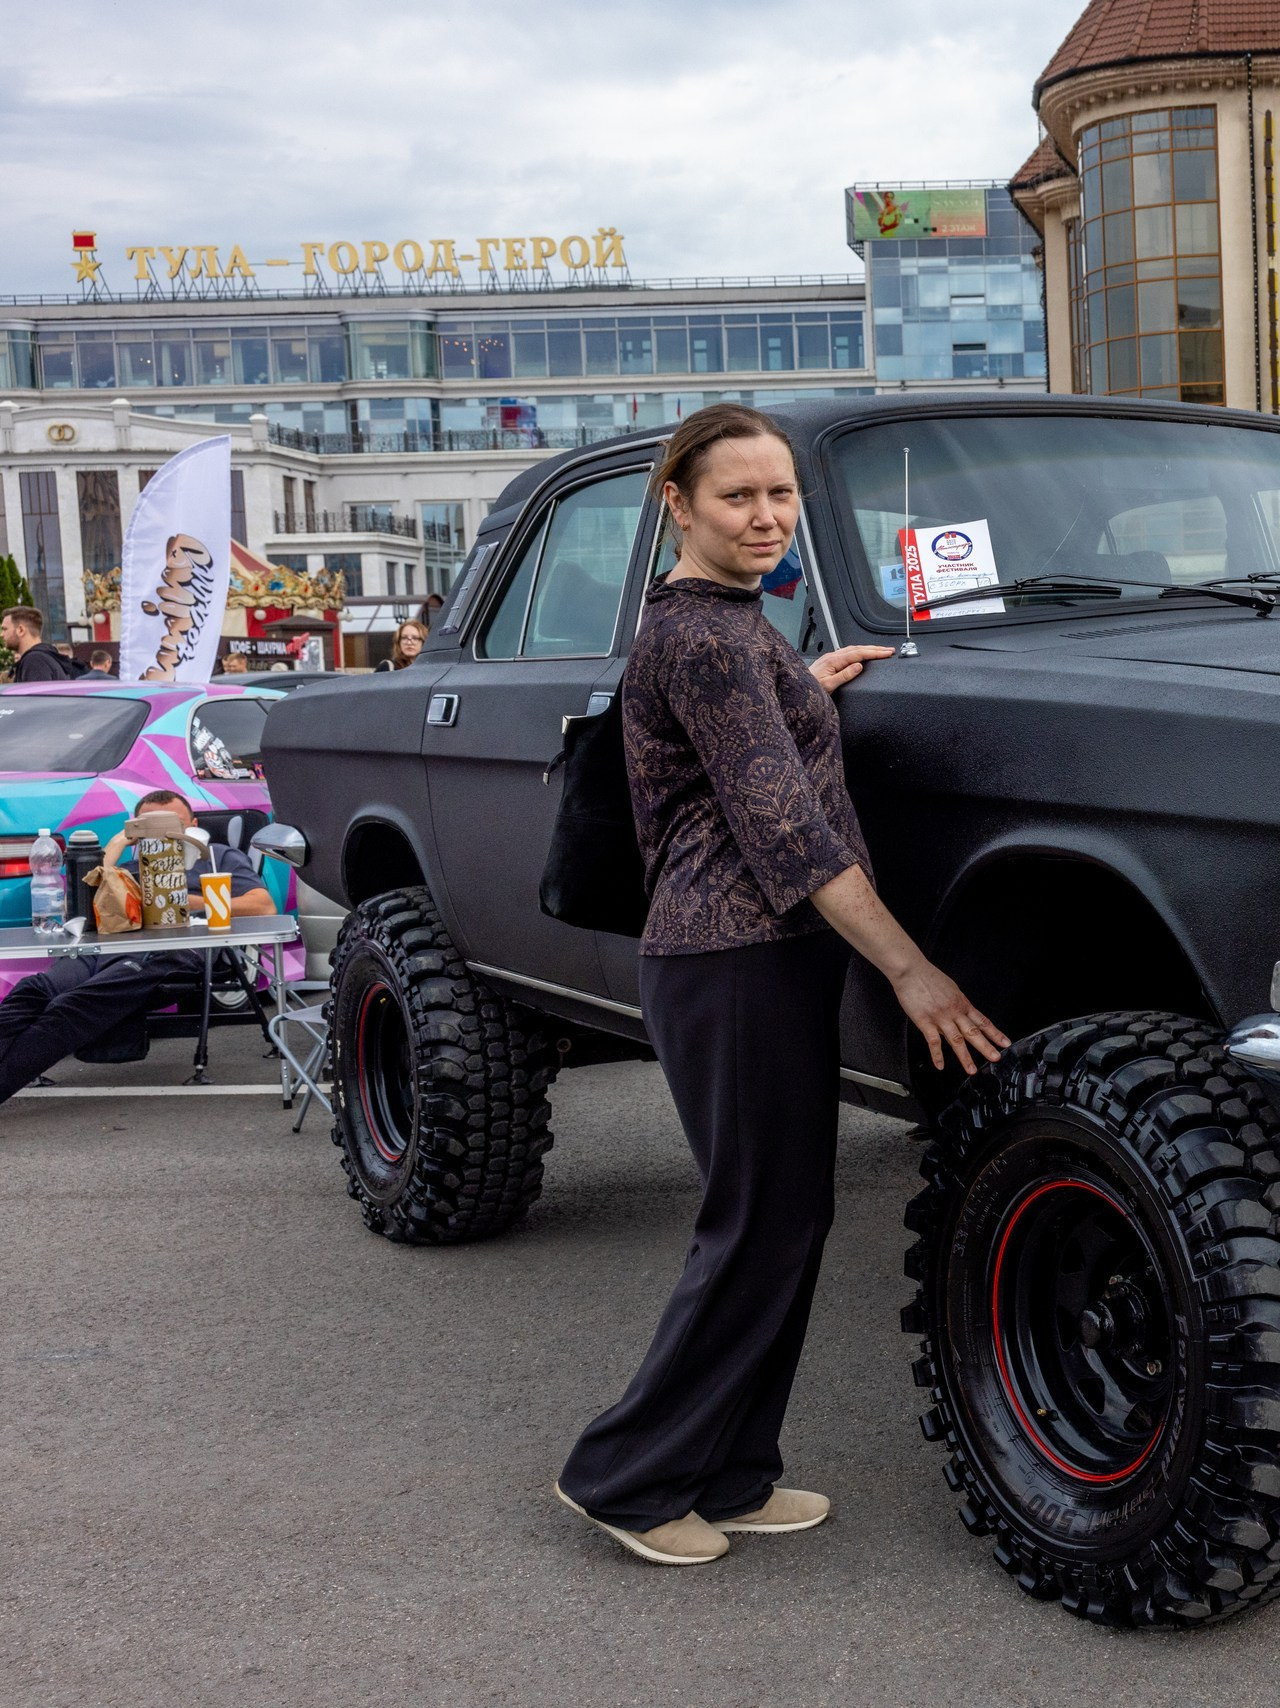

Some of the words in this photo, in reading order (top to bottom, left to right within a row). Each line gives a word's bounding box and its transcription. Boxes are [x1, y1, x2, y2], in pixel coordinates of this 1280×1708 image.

[126, 244, 256, 280] ТУЛА
[301, 227, 625, 278] ГОРОД-ГЕРОЙ
[906, 545, 921, 572] 2025
[910, 574, 927, 604] ТУЛА
[229, 640, 251, 654] КОФЕ
